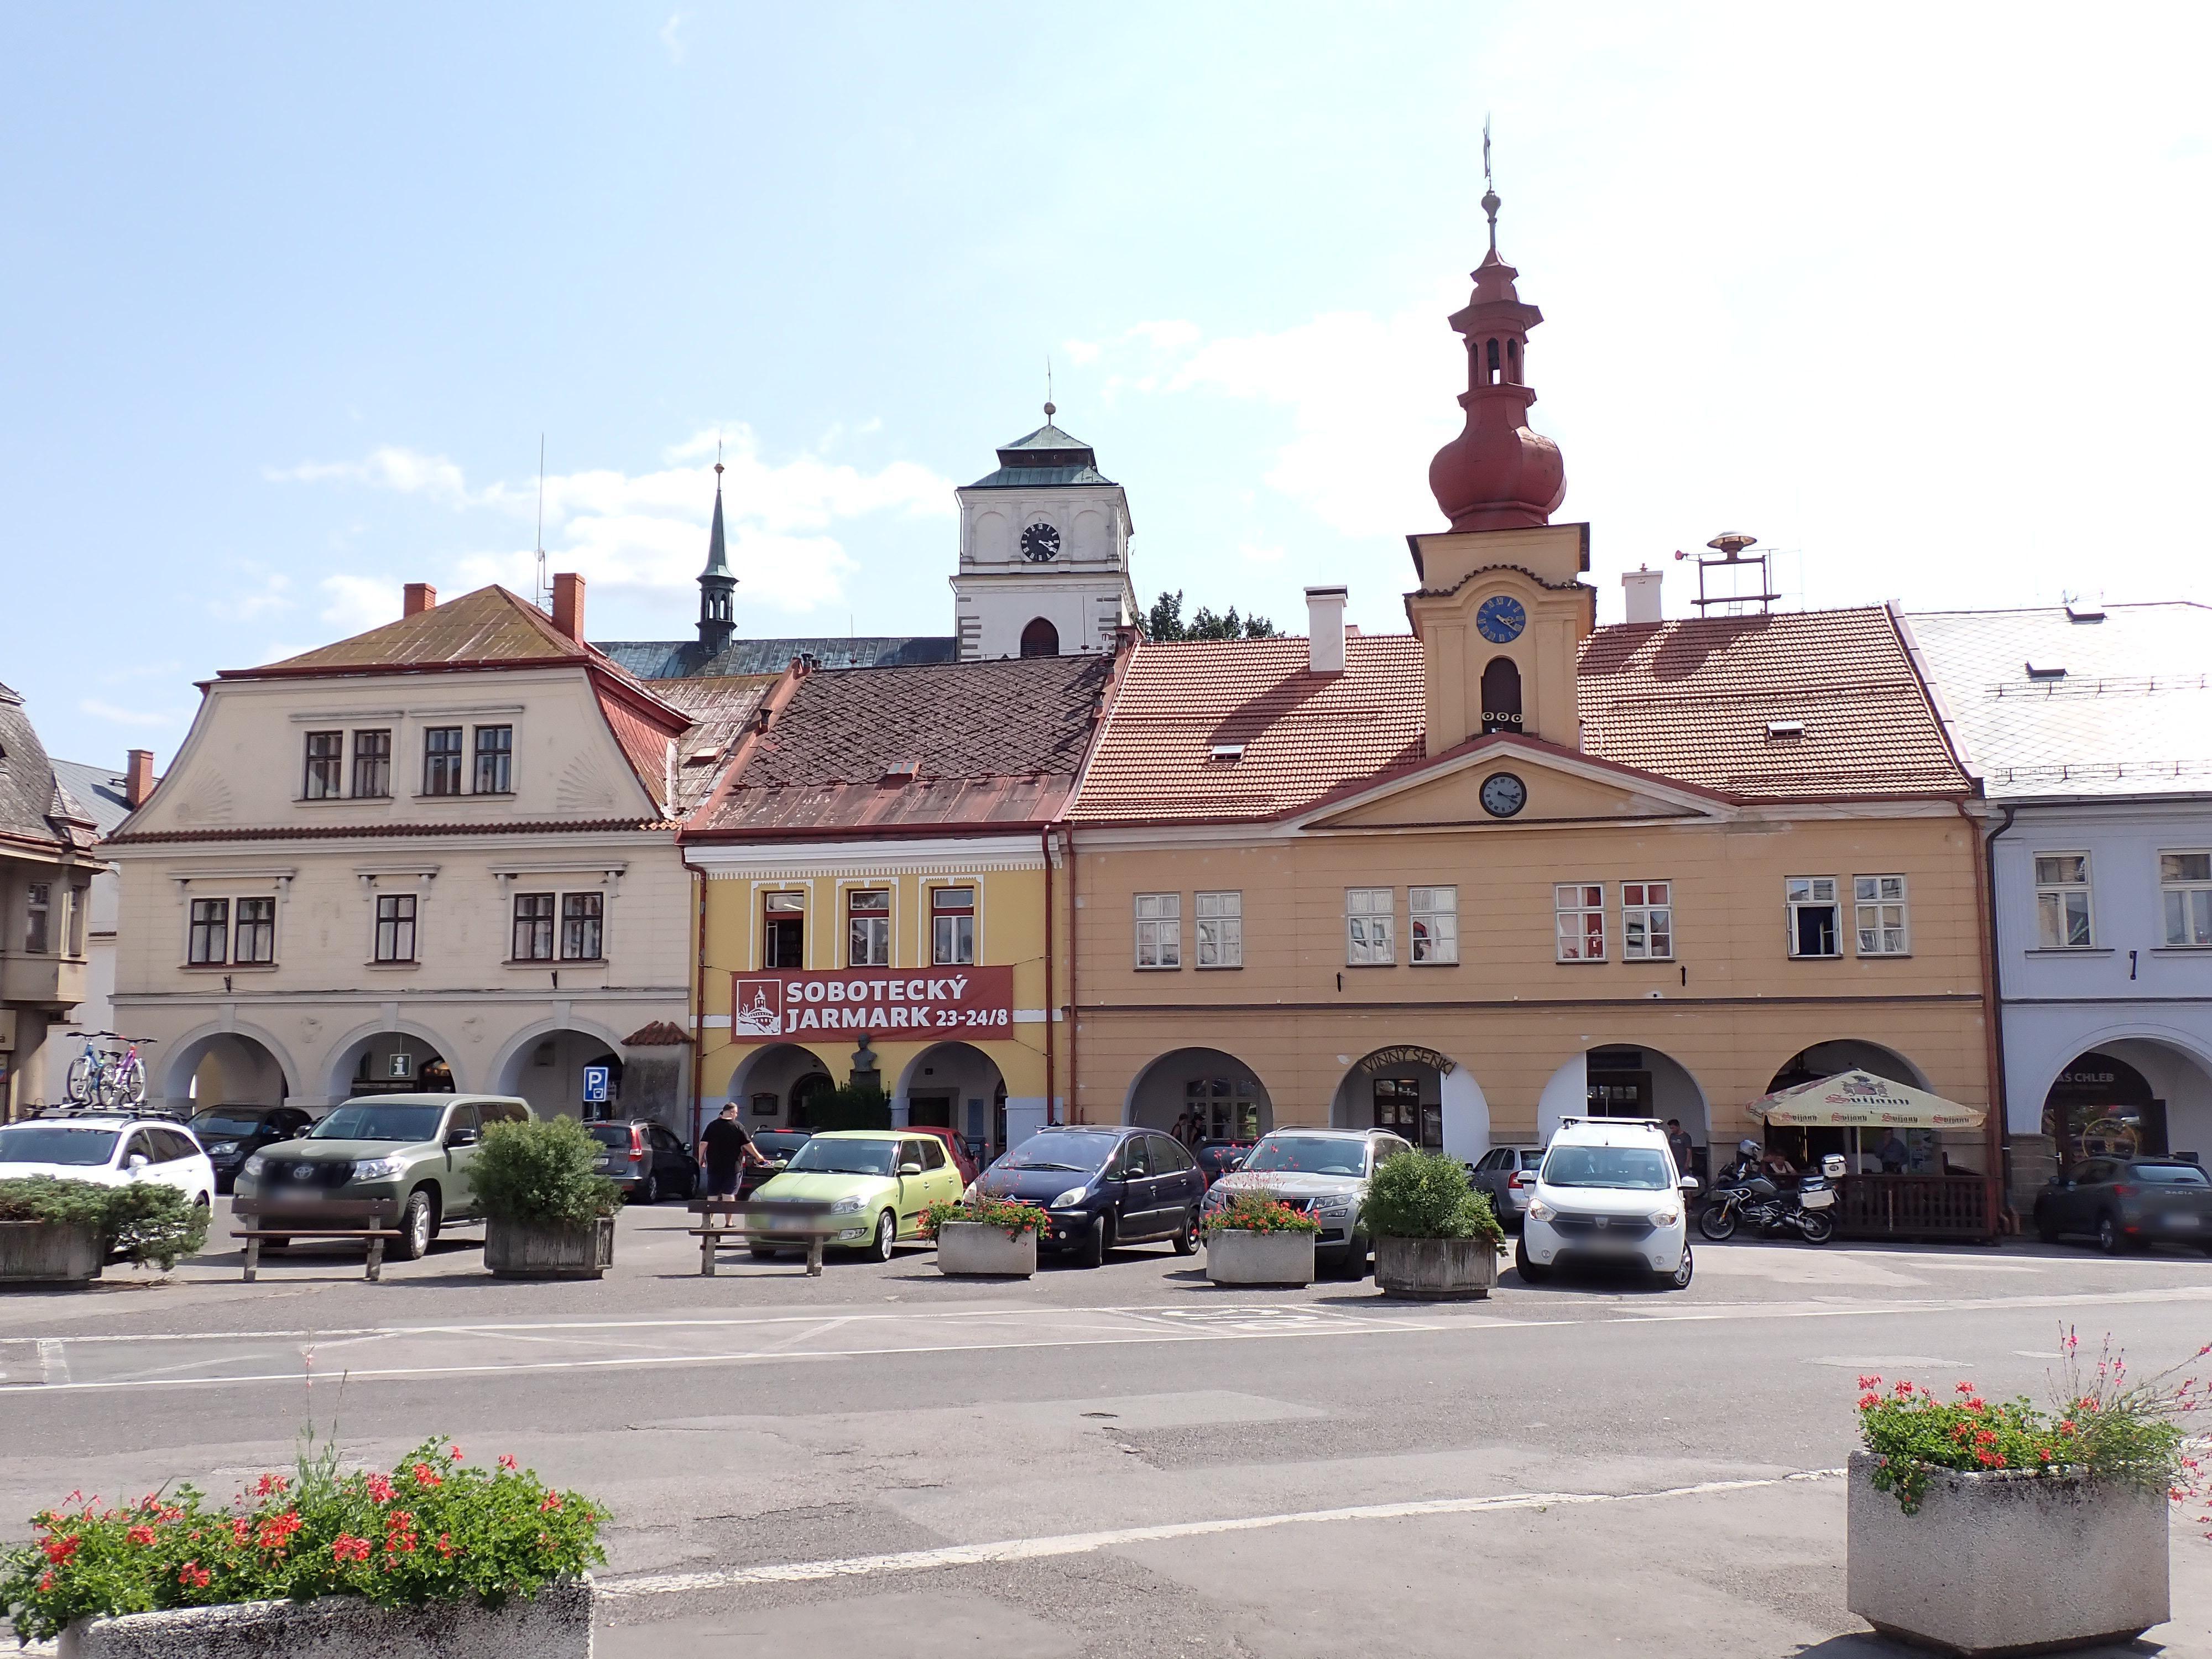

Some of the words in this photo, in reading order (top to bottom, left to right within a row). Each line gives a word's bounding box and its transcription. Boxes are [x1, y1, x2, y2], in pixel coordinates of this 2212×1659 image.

[786, 974, 968, 1003] SOBOTECKÝ
[785, 1006, 931, 1034] JARMARK
[936, 1009, 1008, 1027] 23-24/8
[588, 1071, 602, 1091] P
[1824, 1093, 1910, 1105] Svijany
[1781, 1112, 1818, 1122] Svijany
[1831, 1112, 1867, 1122] Svijany
[1881, 1113, 1918, 1123] Svijany
[1933, 1114, 1969, 1124] Svijany
